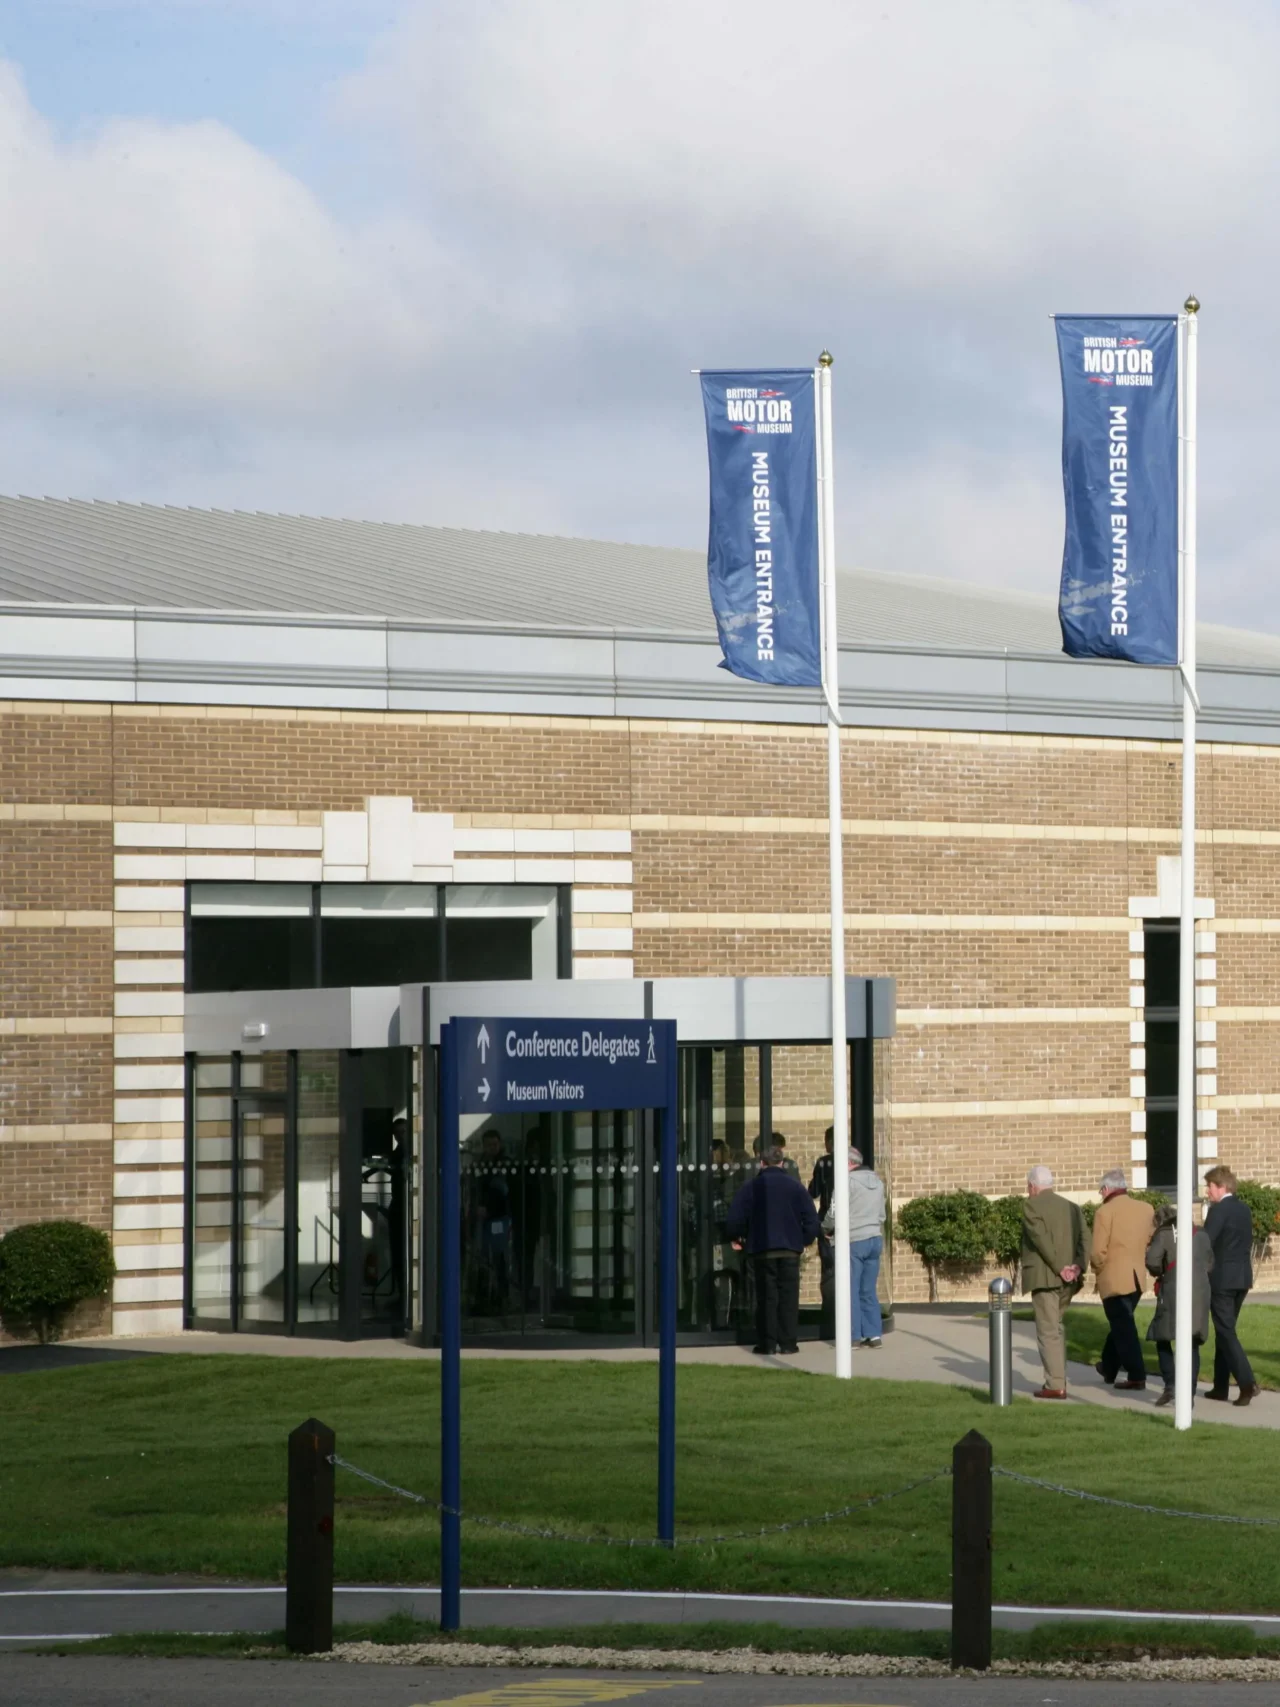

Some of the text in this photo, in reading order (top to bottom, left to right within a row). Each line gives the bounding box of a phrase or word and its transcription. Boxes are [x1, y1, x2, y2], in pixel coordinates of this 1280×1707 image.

[1084, 337, 1117, 348] BRITISH
[1084, 349, 1153, 373] MOTOR
[1116, 375, 1153, 386] MUSEUM
[726, 388, 758, 399] BRITISH
[727, 400, 792, 422] MOTOR
[757, 423, 792, 434] MUSEUM
[1109, 406, 1128, 636] MUSEUM ENTRANCE
[752, 452, 774, 661] MUSEUM ENTRANCE
[505, 1030, 641, 1065] Conference Delegates
[506, 1080, 585, 1101] Museum Visitors
